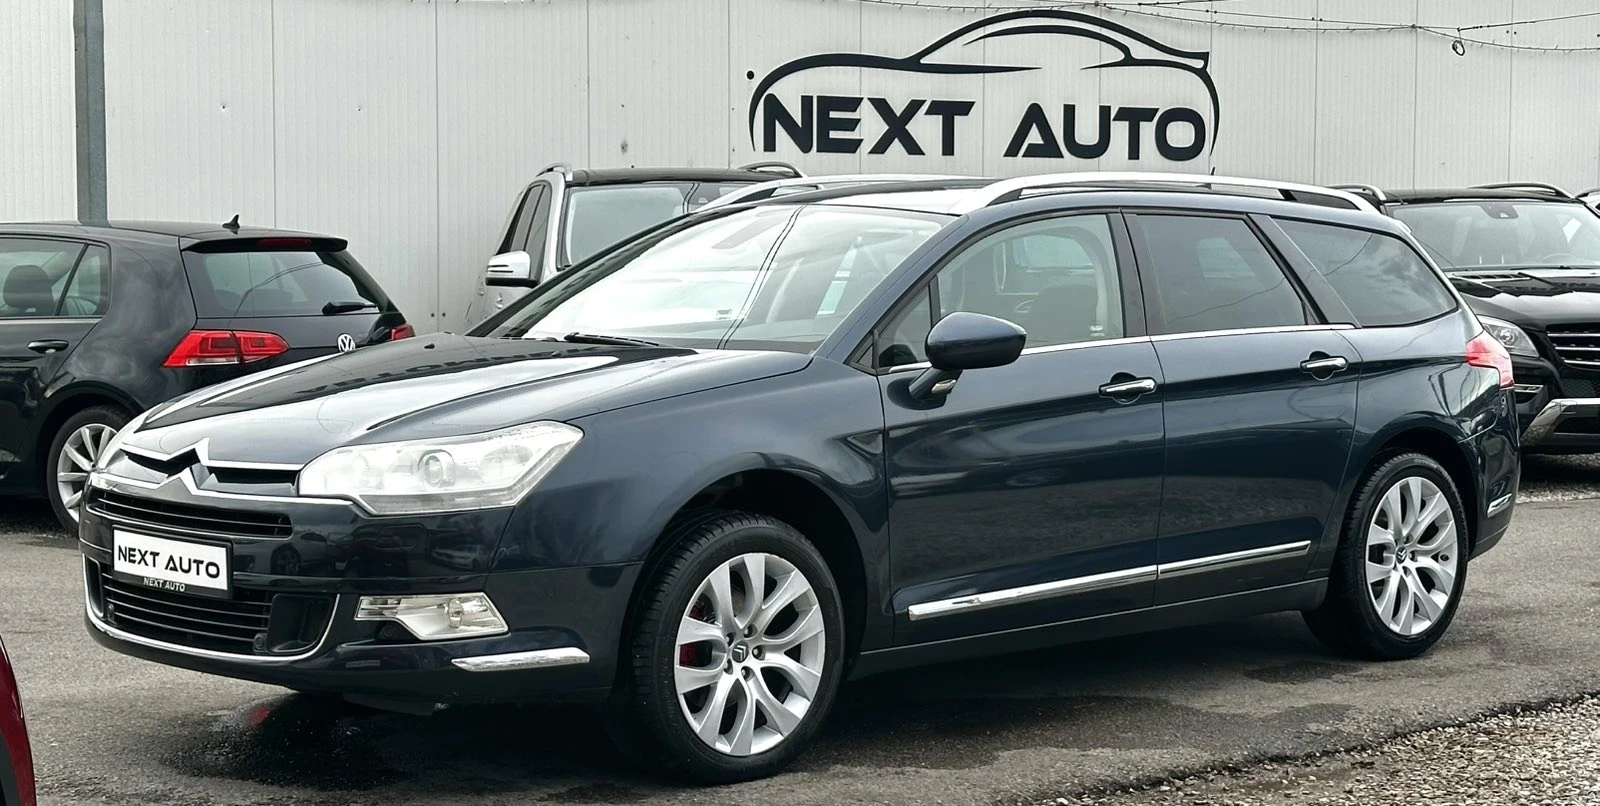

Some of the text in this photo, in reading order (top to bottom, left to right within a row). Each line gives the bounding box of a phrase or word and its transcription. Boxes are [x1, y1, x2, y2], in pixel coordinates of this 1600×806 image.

[763, 93, 1206, 161] NEXT AUTO
[118, 545, 220, 579] NEXT AUTO
[143, 577, 186, 592] NEXT AUTO
